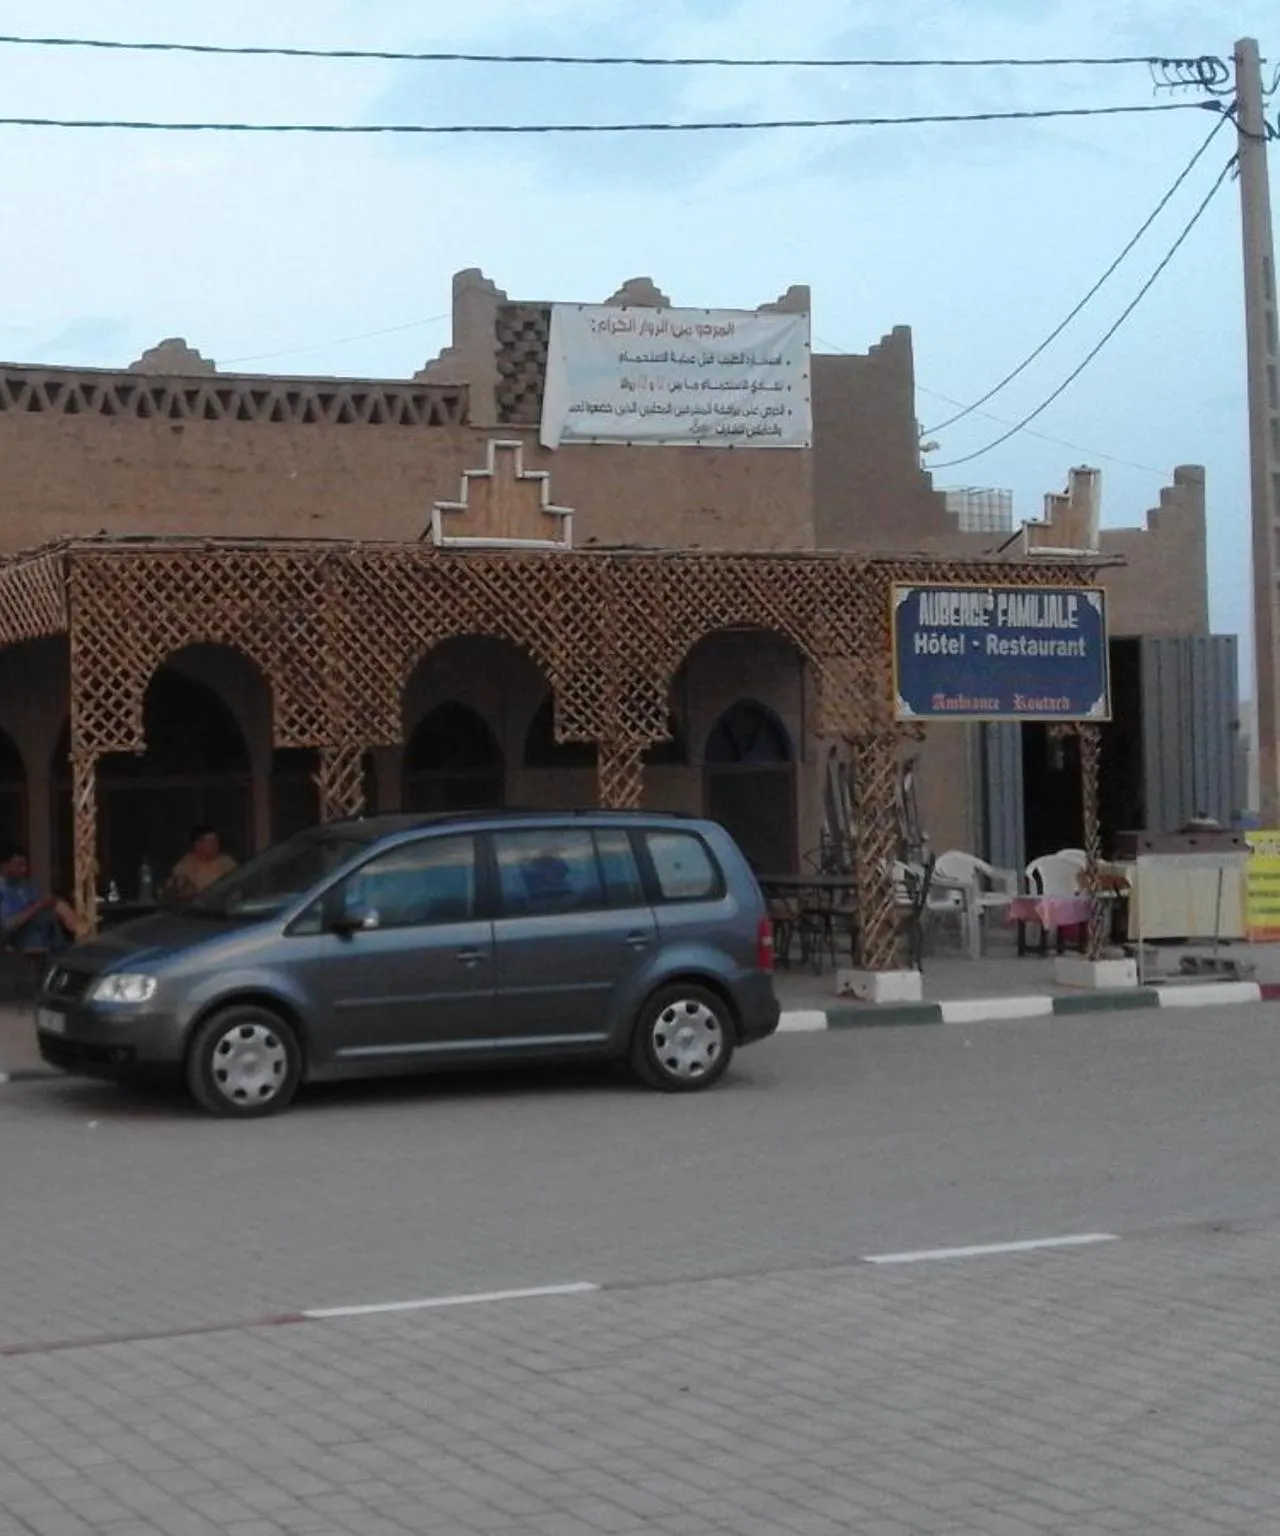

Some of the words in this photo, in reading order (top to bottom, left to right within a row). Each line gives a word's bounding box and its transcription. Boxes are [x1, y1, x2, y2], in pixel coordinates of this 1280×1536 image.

[919, 591, 990, 628] AUBERGE
[997, 593, 1078, 629] FAMILIALE
[913, 632, 965, 655] Hôtel
[986, 634, 1086, 657] Restaurant
[1013, 693, 1070, 711] Routard
